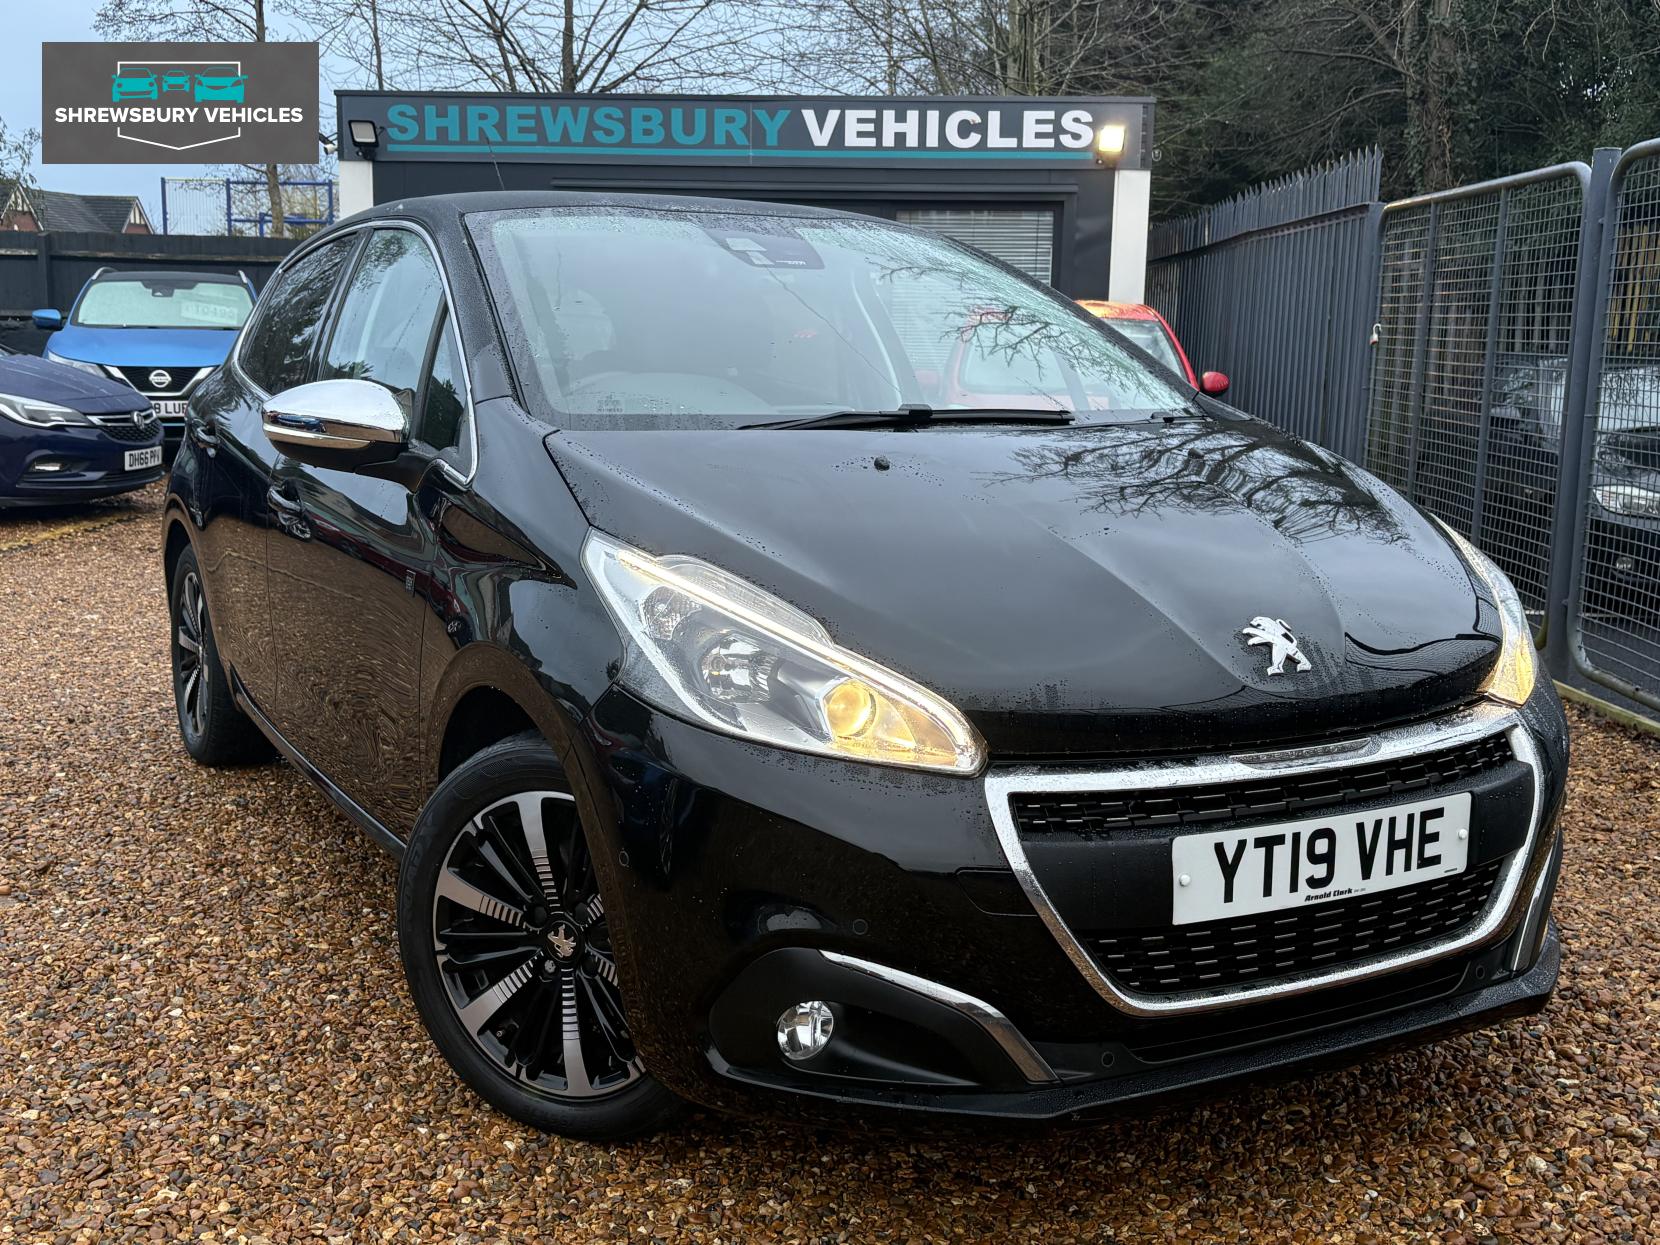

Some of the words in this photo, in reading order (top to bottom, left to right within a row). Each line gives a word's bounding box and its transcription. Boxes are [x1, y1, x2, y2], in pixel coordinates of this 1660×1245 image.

[387, 104, 791, 146] SHREWSBURY
[801, 109, 1094, 149] VEHICLES
[128, 450, 149, 468] DH66
[1213, 827, 1337, 904] YT19
[1355, 806, 1445, 881] VHE
[1304, 890, 1332, 902] Arnold
[1332, 887, 1353, 897] Clark
